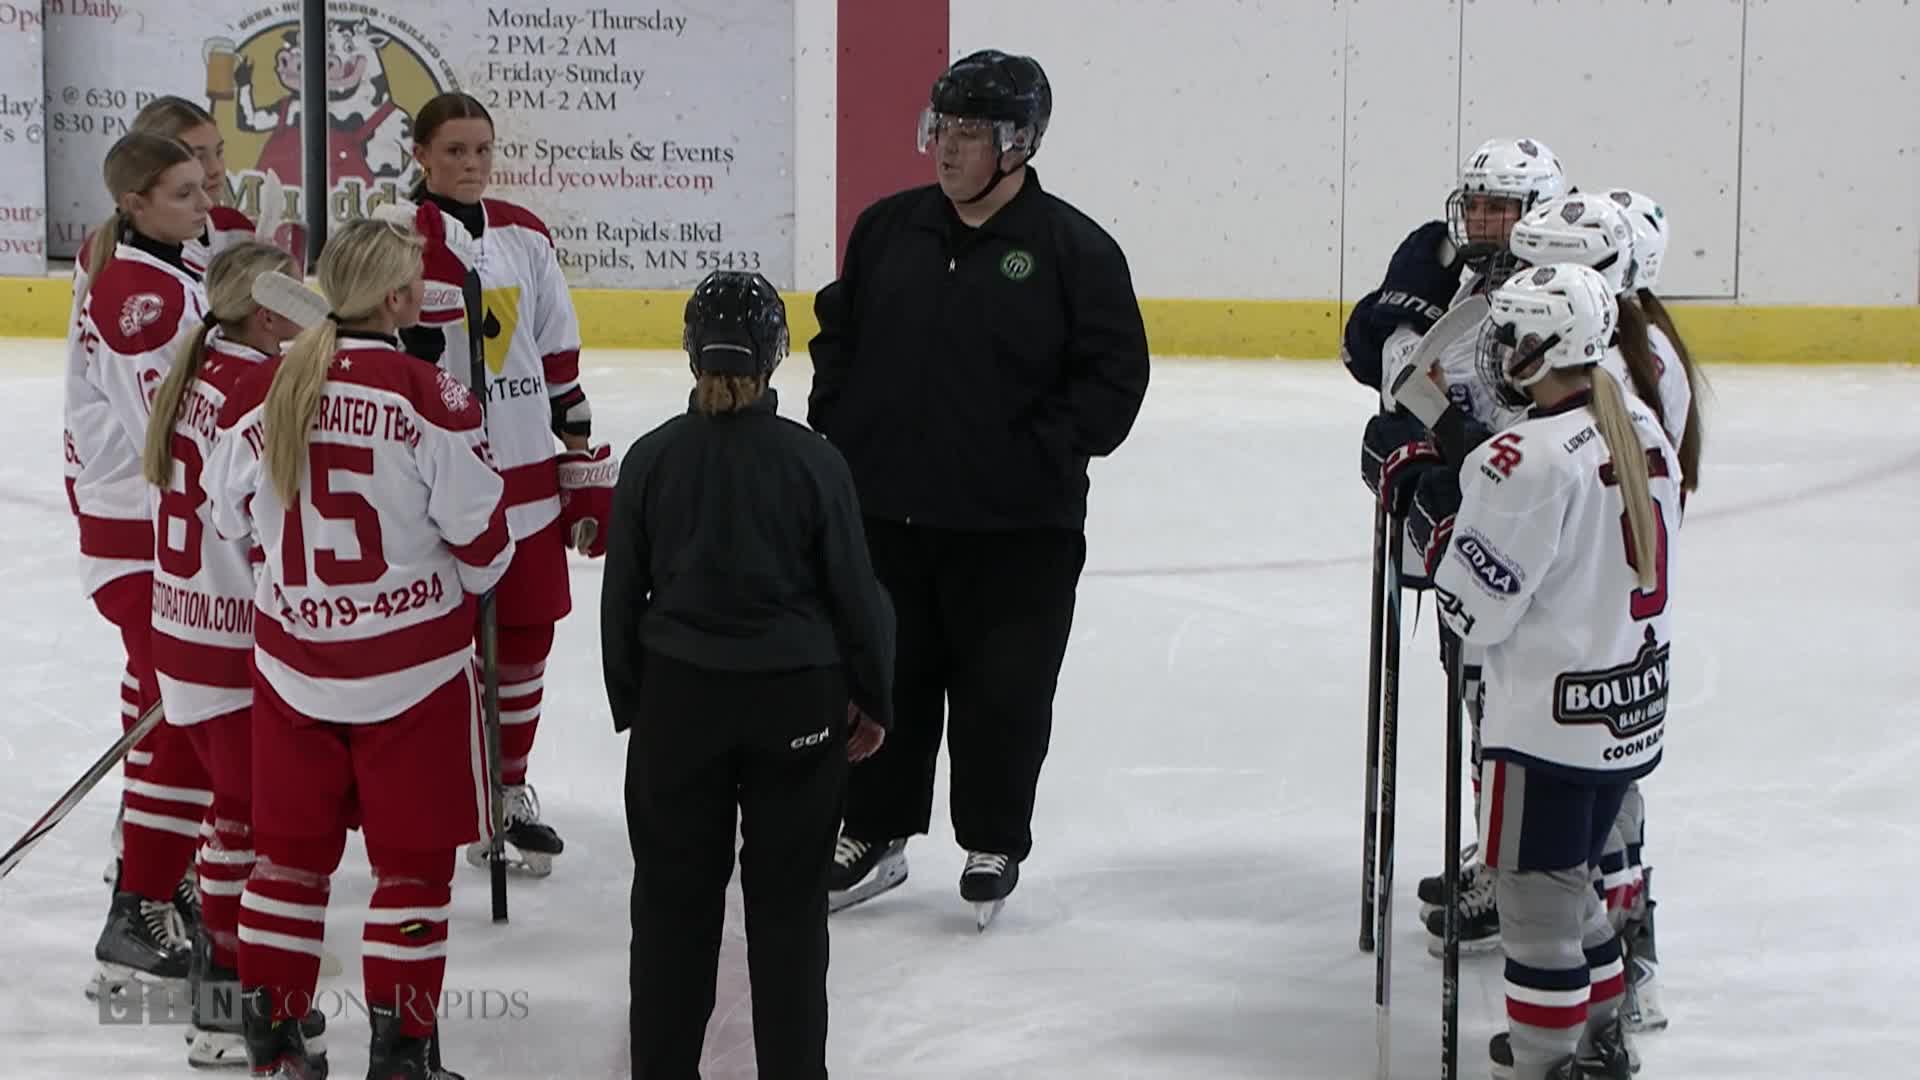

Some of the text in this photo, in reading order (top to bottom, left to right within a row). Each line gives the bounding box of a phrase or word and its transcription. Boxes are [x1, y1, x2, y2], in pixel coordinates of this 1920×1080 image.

[487, 8, 688, 37] Monday-Thursday
[487, 35, 500, 55] 2
[576, 37, 618, 57] AM
[487, 63, 646, 90] Friday-Sunday
[86, 87, 127, 109] 6:30
[487, 90, 500, 110] 2
[576, 92, 618, 112] AM
[53, 112, 94, 134] 8:30
[535, 138, 624, 166] Specials
[629, 143, 656, 161] &
[661, 140, 734, 163] Events
[488, 165, 715, 193] muddycowbar.com
[597, 221, 668, 248] Rapids
[681, 222, 721, 242] Blvd
[645, 249, 687, 270] MN
[695, 250, 761, 270] 55433
[312, 394, 377, 437] RATED
[280, 441, 389, 587] 15
[1602, 738, 1644, 762] COON
